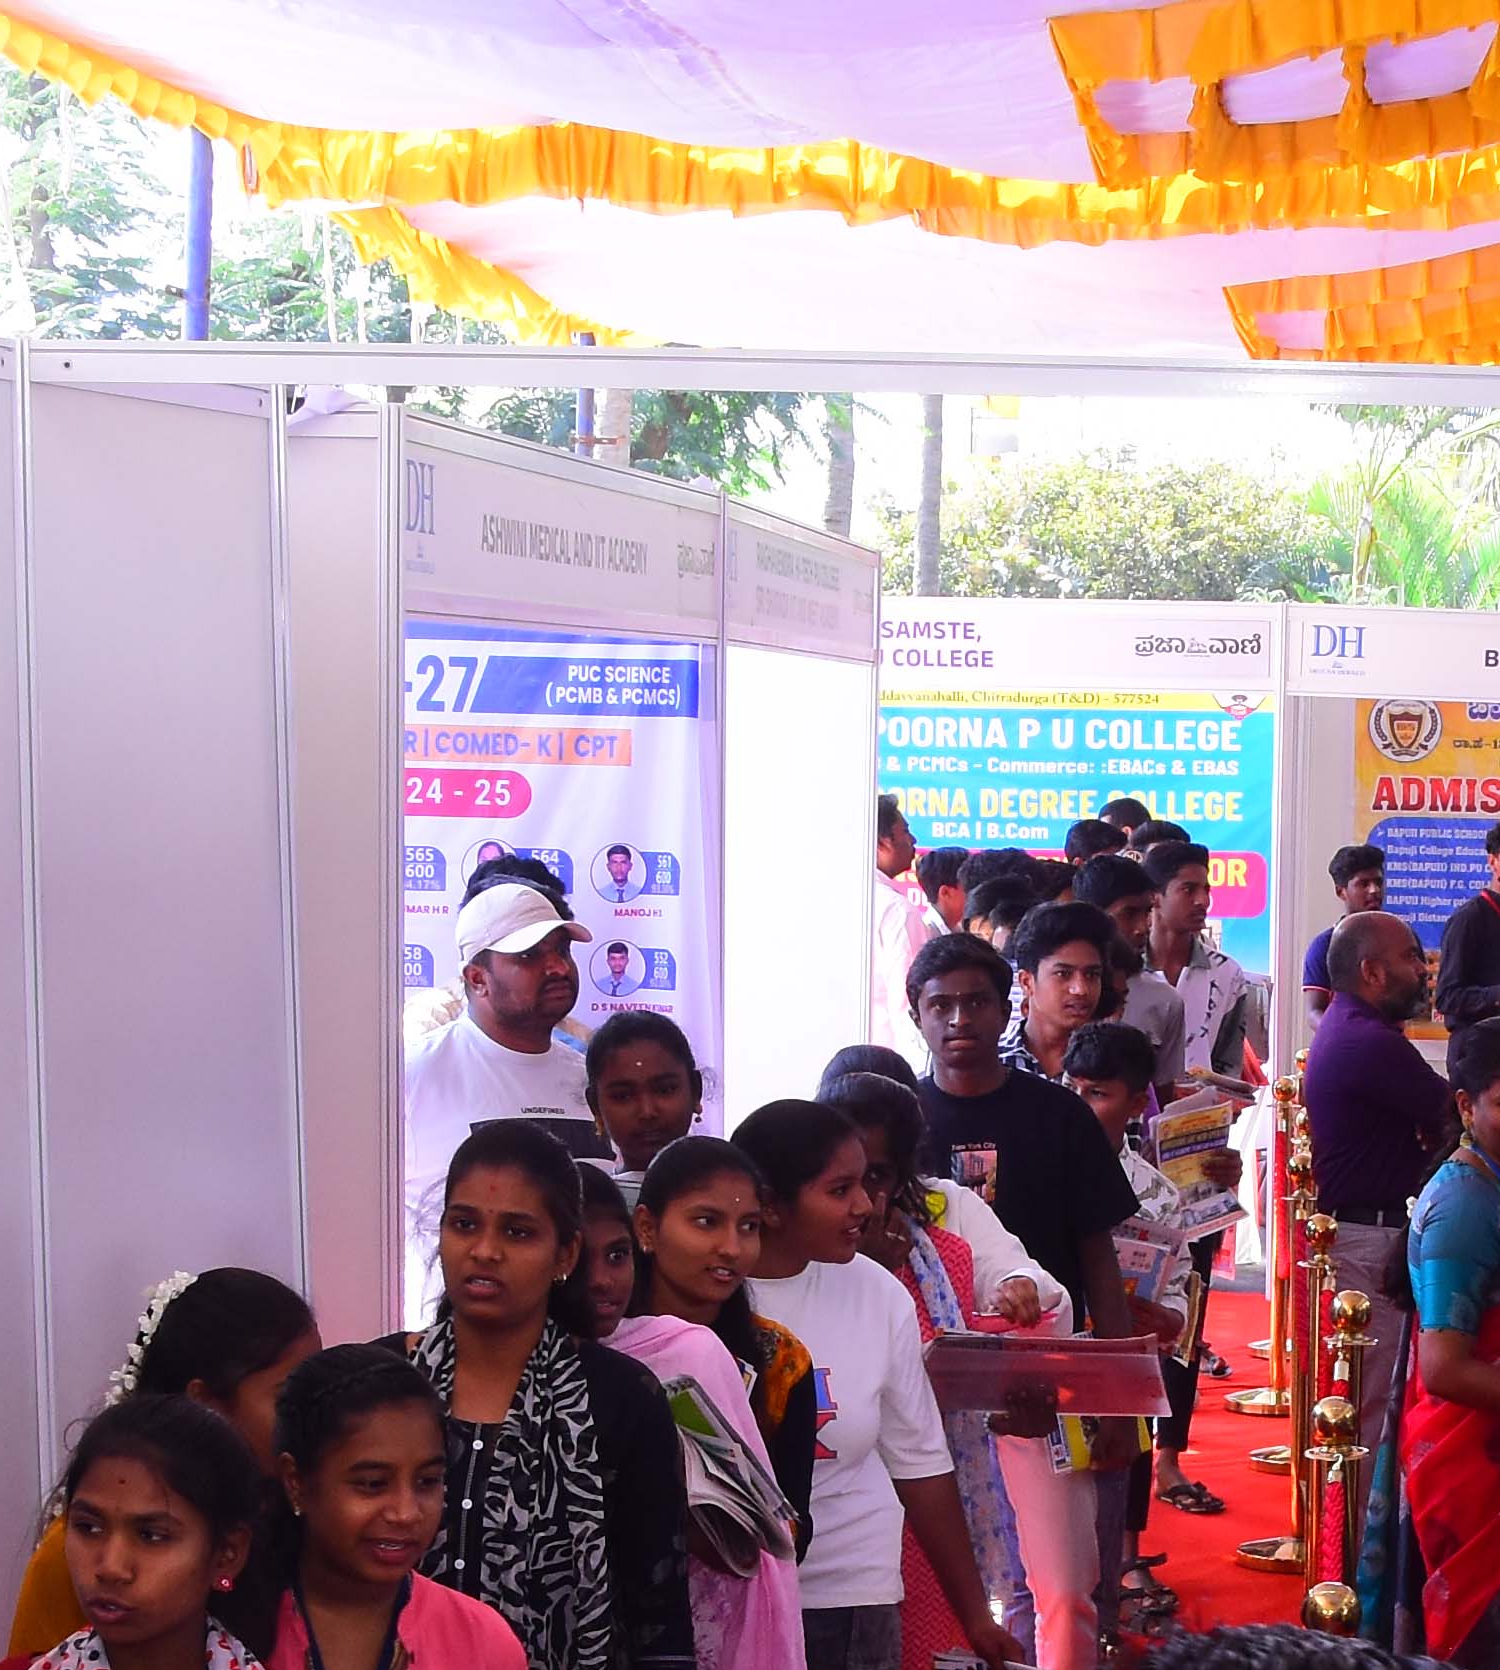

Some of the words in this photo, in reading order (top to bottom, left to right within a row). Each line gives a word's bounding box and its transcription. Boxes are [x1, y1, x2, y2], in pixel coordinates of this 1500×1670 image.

[406, 459, 435, 535] DH
[530, 523, 571, 564] MEDICAL
[881, 622, 982, 642] SAMSTE,
[1312, 625, 1365, 657] DH
[892, 649, 994, 667] COLLEGE
[567, 665, 600, 682] PUC
[604, 666, 671, 683] SCIENCE
[606, 688, 619, 705] &
[621, 684, 681, 710] PCMCS)
[1052, 691, 1101, 705] (T&D)
[1113, 693, 1160, 705] 577524
[573, 734, 618, 757] CPT
[1019, 719, 1040, 749] P
[1052, 719, 1074, 749] U
[1085, 719, 1242, 752] COLLEGE
[887, 758, 900, 771] &
[907, 757, 968, 772] PCMCs
[1171, 761, 1186, 775] &
[1192, 760, 1239, 776] EBAS
[406, 777, 442, 804] 24
[474, 779, 511, 806] 25
[981, 790, 1098, 820] DEGREE
[932, 822, 970, 838] BCA
[987, 822, 1049, 840] B.Com
[1420, 829, 1451, 839] PUBLIC
[405, 847, 434, 862] 565
[404, 866, 434, 879] 600
